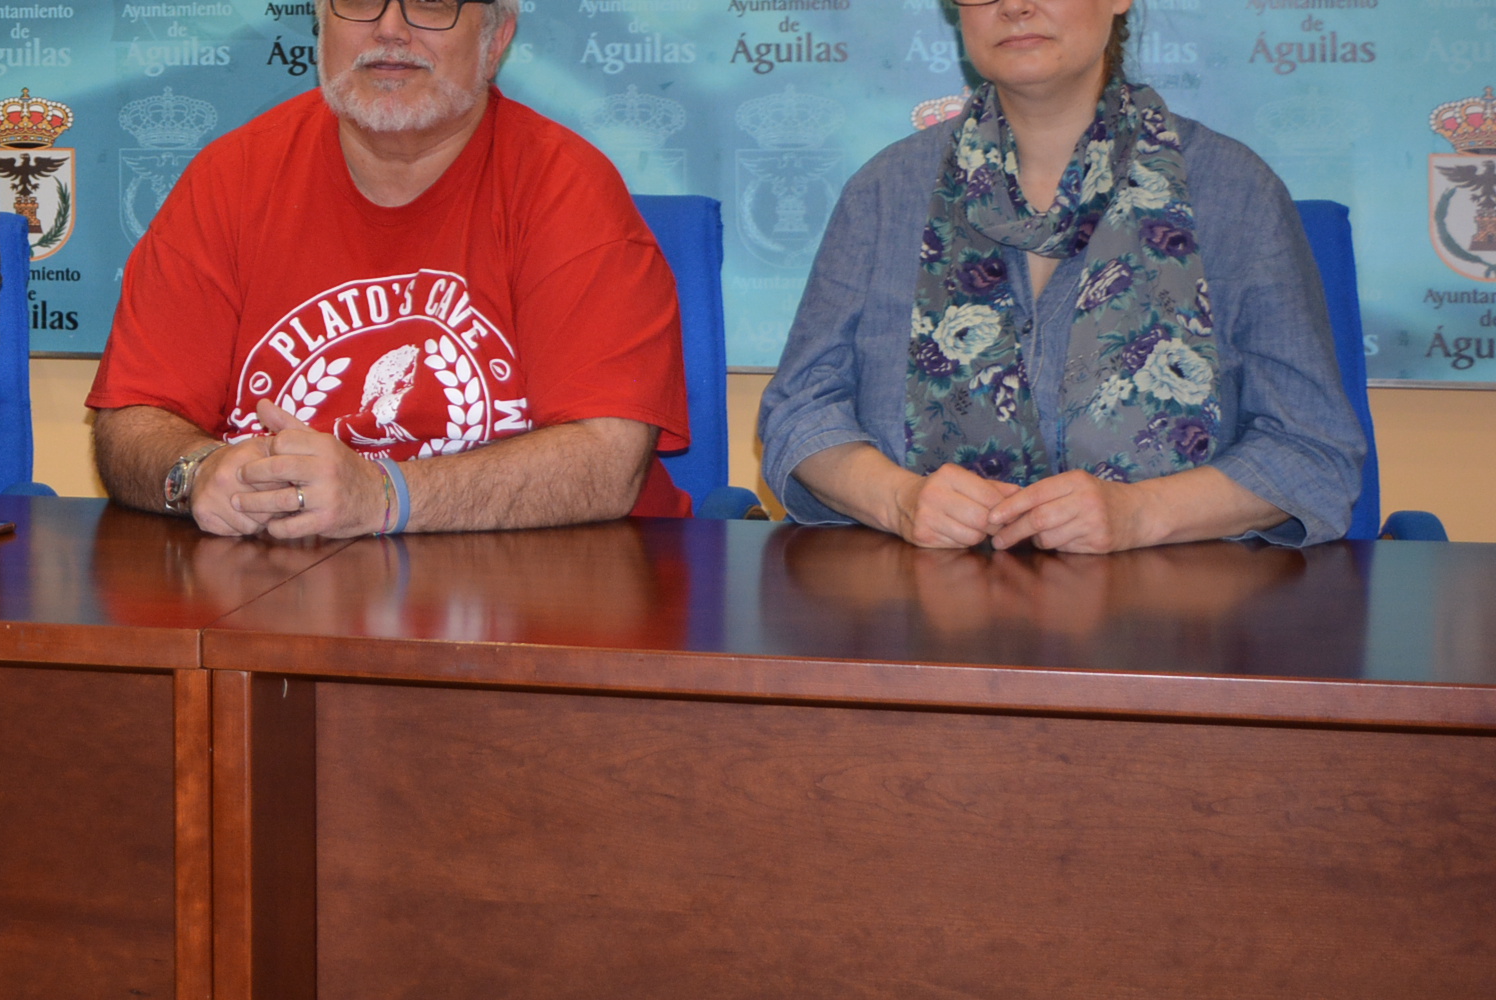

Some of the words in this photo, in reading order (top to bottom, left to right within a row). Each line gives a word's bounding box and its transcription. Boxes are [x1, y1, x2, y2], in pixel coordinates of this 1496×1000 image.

[121, 0, 233, 23] Ayuntamiento
[777, 14, 801, 34] de
[1300, 14, 1324, 33] de
[10, 21, 31, 39] de
[167, 20, 188, 38] de
[124, 35, 232, 77] Águilas
[579, 32, 697, 74] Águilas
[730, 32, 849, 76] Águilas
[1248, 31, 1378, 76] Águilas
[29, 266, 82, 282] miento
[32, 300, 80, 332] ilas
[268, 279, 416, 367] PLATO'S
[424, 278, 489, 350] CAVE
